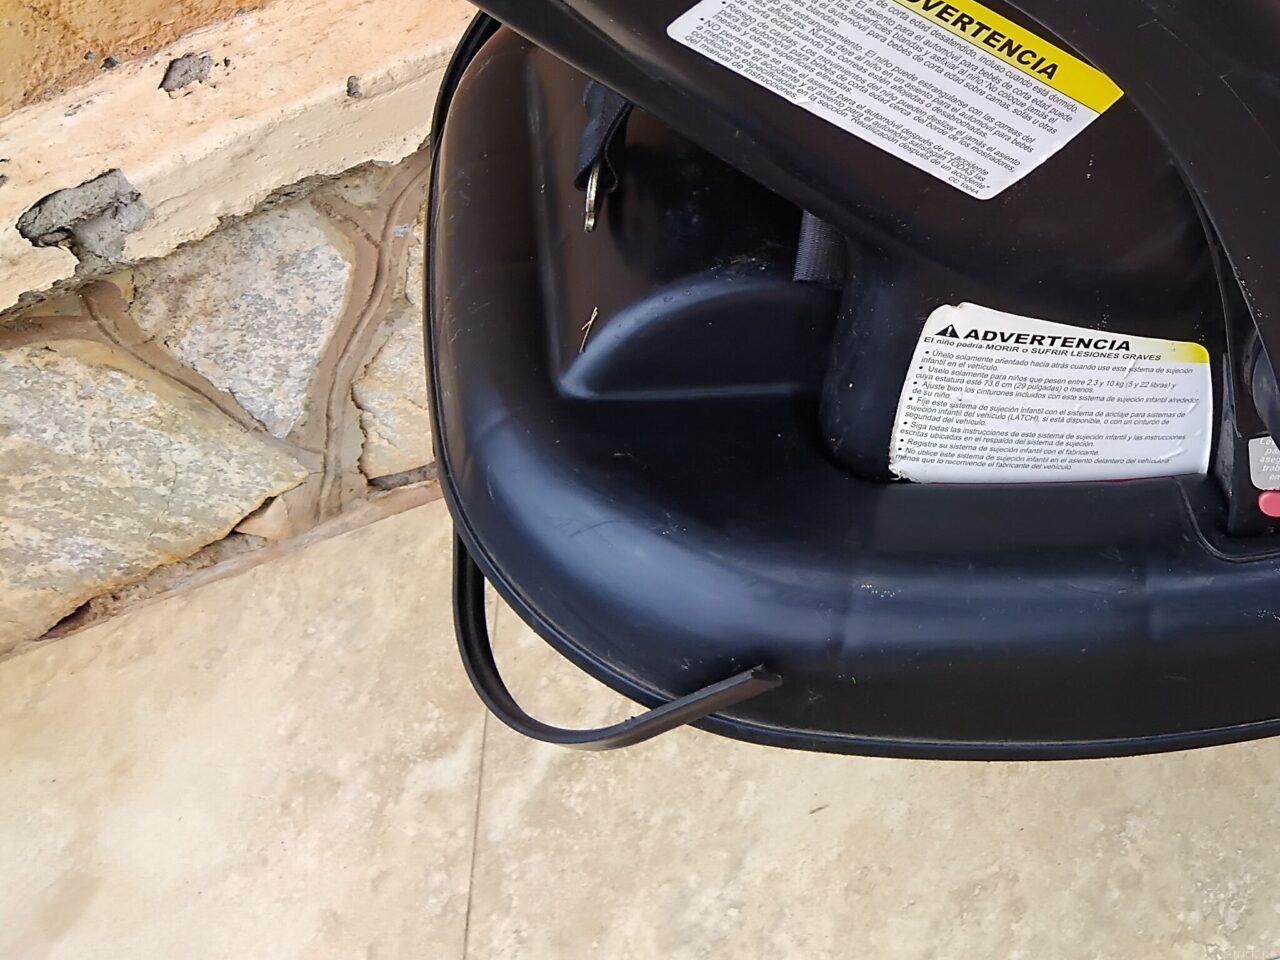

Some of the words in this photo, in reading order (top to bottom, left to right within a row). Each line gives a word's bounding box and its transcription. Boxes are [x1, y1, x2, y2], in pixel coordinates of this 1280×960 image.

[805, 5, 838, 27] blandas.
[835, 0, 849, 10] las
[848, 9, 892, 35] superficies
[892, 32, 924, 52] blandas
[930, 54, 958, 71] asfixiar
[997, 91, 1027, 108] coloque
[1024, 105, 1049, 119] jamás
[888, 6, 910, 20] corta
[909, 18, 932, 32] edad
[978, 55, 1006, 73] incluso
[1005, 71, 1033, 88] cuando
[1032, 86, 1050, 97] está
[808, 29, 836, 46] Nunca
[836, 44, 855, 56] deje
[863, 60, 882, 71] niño
[905, 83, 933, 99] asiento
[931, 98, 951, 109] para
[959, 112, 996, 132] automóvil
[993, 130, 1012, 141] para
[1011, 138, 1034, 153] bebés
[827, 8, 870, 32] automóvil
[866, 30, 887, 42] para
[886, 40, 913, 56] bebés
[923, 61, 944, 73] corta
[943, 72, 965, 84] edad
[963, 83, 985, 96] sobre
[1012, 109, 1033, 121] sofás
[1038, 122, 1058, 134] otras
[865, 7, 896, 26] asiento
[893, 24, 915, 36] para
[923, 39, 962, 61] automóvil
[958, 59, 979, 71] para
[978, 68, 1002, 84] bebés
[1012, 88, 1032, 100] corta
[1031, 98, 1052, 110] edad
[1048, 108, 1073, 122] puede
[874, 56, 894, 68] niño
[891, 66, 919, 81] puede
[918, 80, 969, 108] estrangularse
[968, 106, 983, 116] con
[982, 113, 995, 122] las
[994, 121, 1022, 137] correas
[1021, 134, 1036, 144] del
[936, 338, 955, 347] niño
[985, 344, 1020, 352] MORIR
[1030, 347, 1068, 356] SUFRIR
[1070, 350, 1120, 359] LESIONES
[1122, 353, 1162, 361] GRAVES
[962, 329, 1131, 352] ADVERTENCIA
